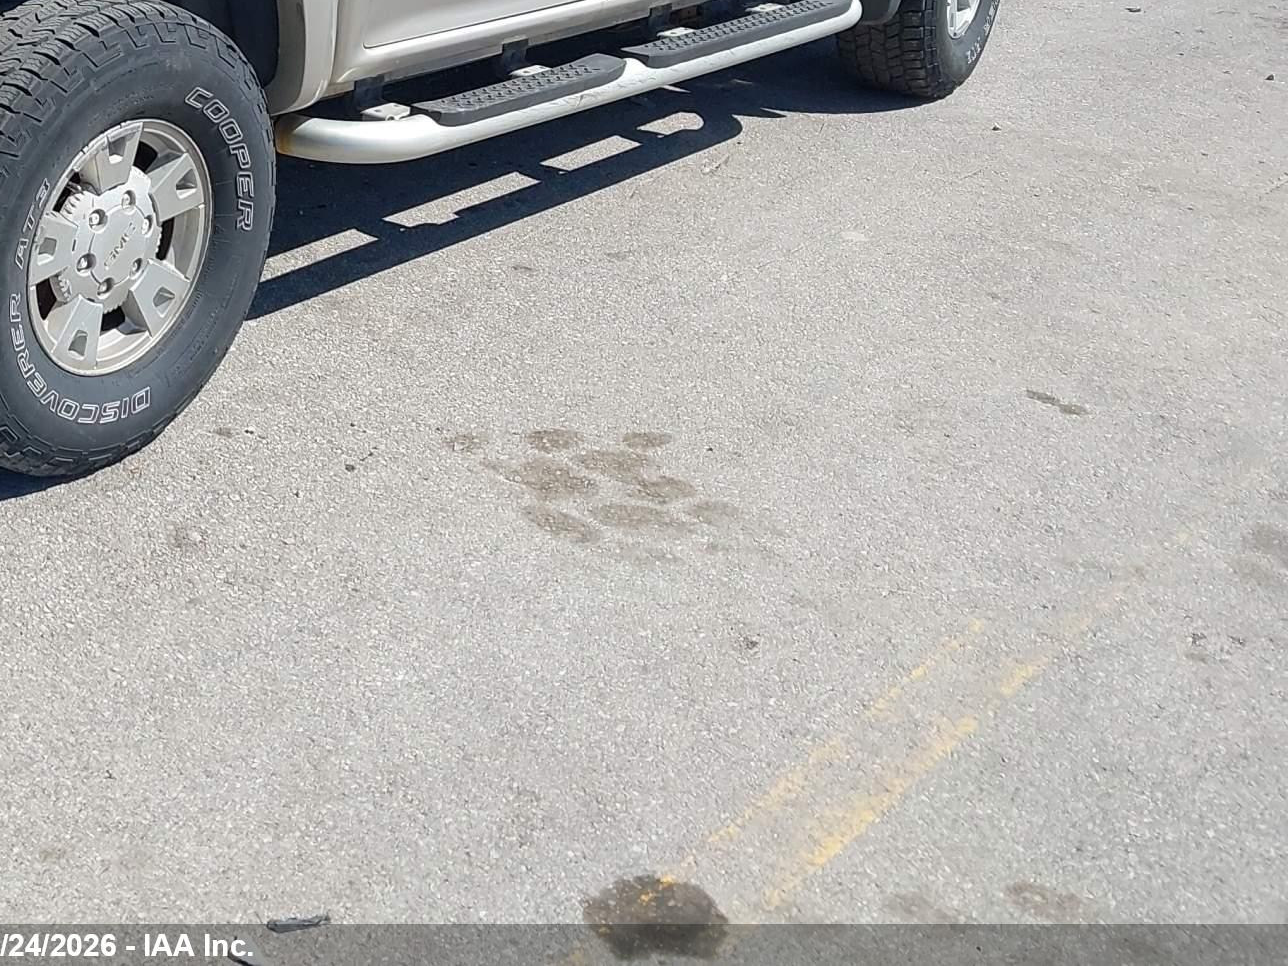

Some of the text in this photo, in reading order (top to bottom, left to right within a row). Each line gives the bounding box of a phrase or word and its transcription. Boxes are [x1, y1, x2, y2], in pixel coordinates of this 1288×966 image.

[185, 86, 255, 231] COOPER
[10, 178, 151, 424] DISCOVERER AT3
